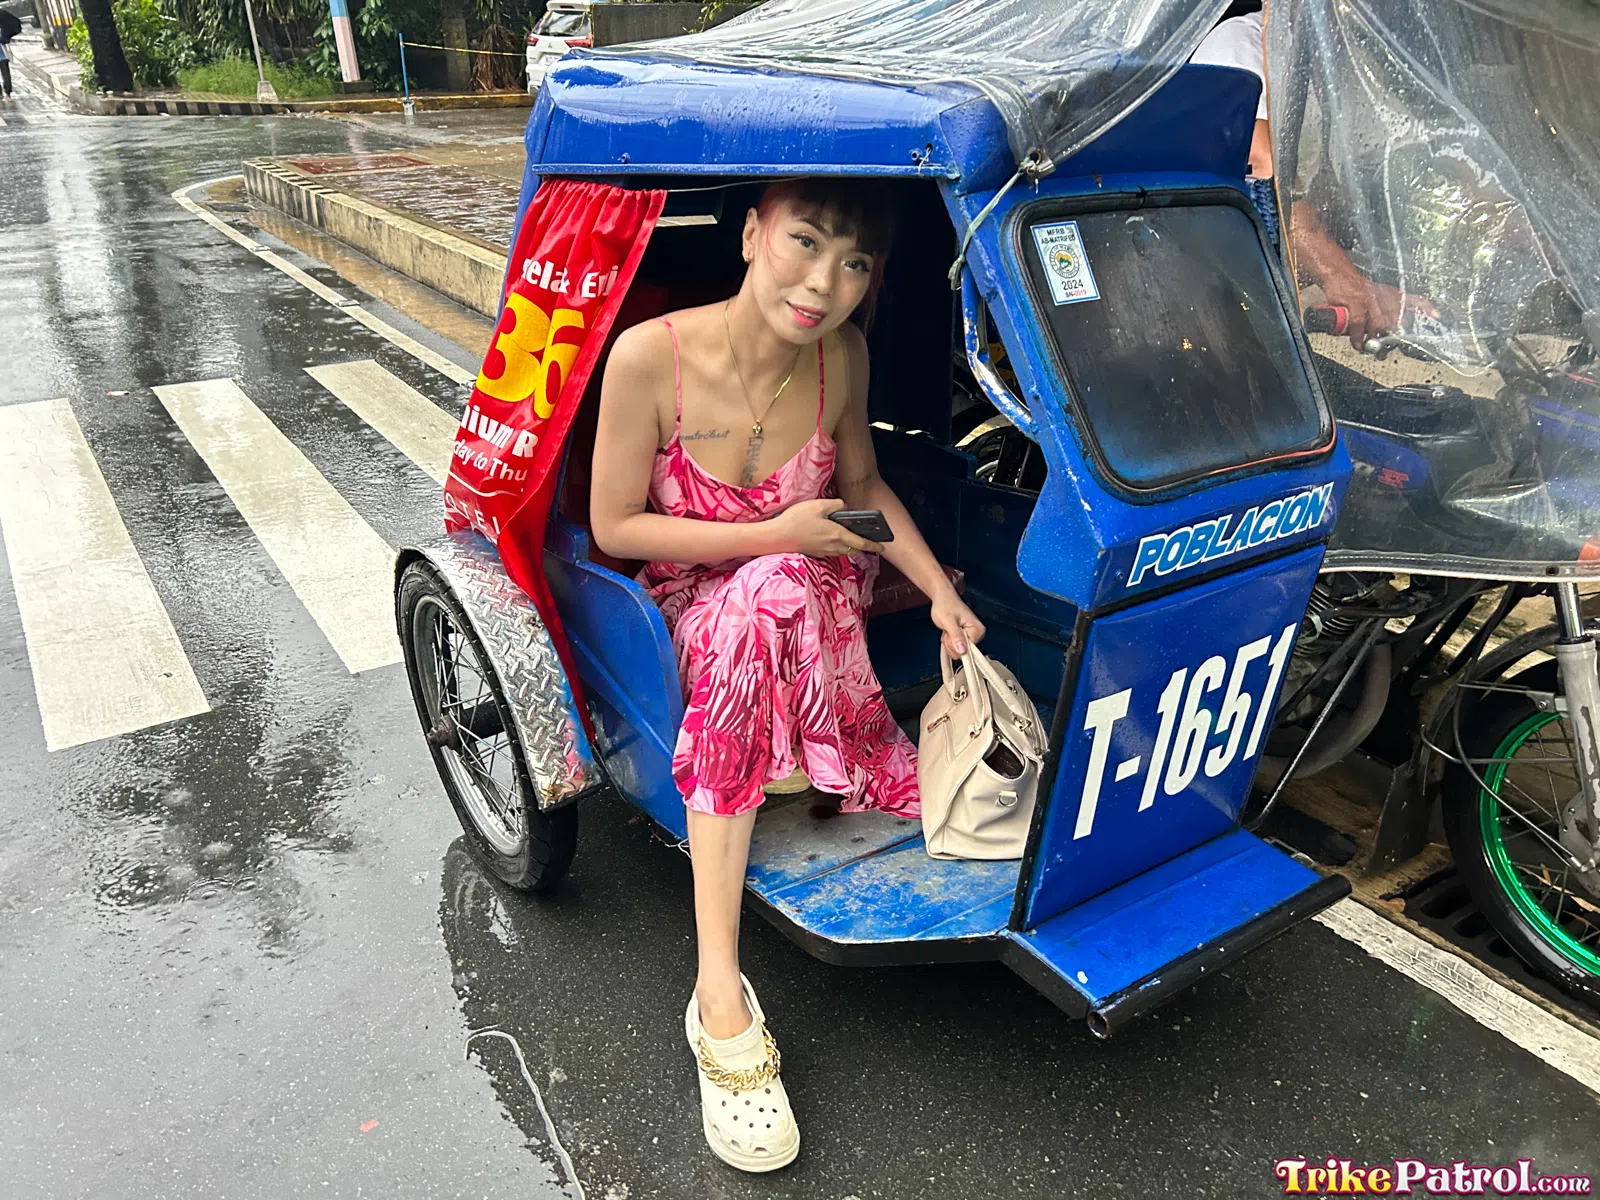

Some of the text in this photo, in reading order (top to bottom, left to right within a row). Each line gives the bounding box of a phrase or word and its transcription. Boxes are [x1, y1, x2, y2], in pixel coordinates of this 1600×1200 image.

[1061, 279, 1083, 291] 2024
[472, 450, 488, 470] to
[488, 456, 528, 481] Thu
[1125, 481, 1335, 588] POBLACION
[1072, 622, 1298, 841] T-1651
